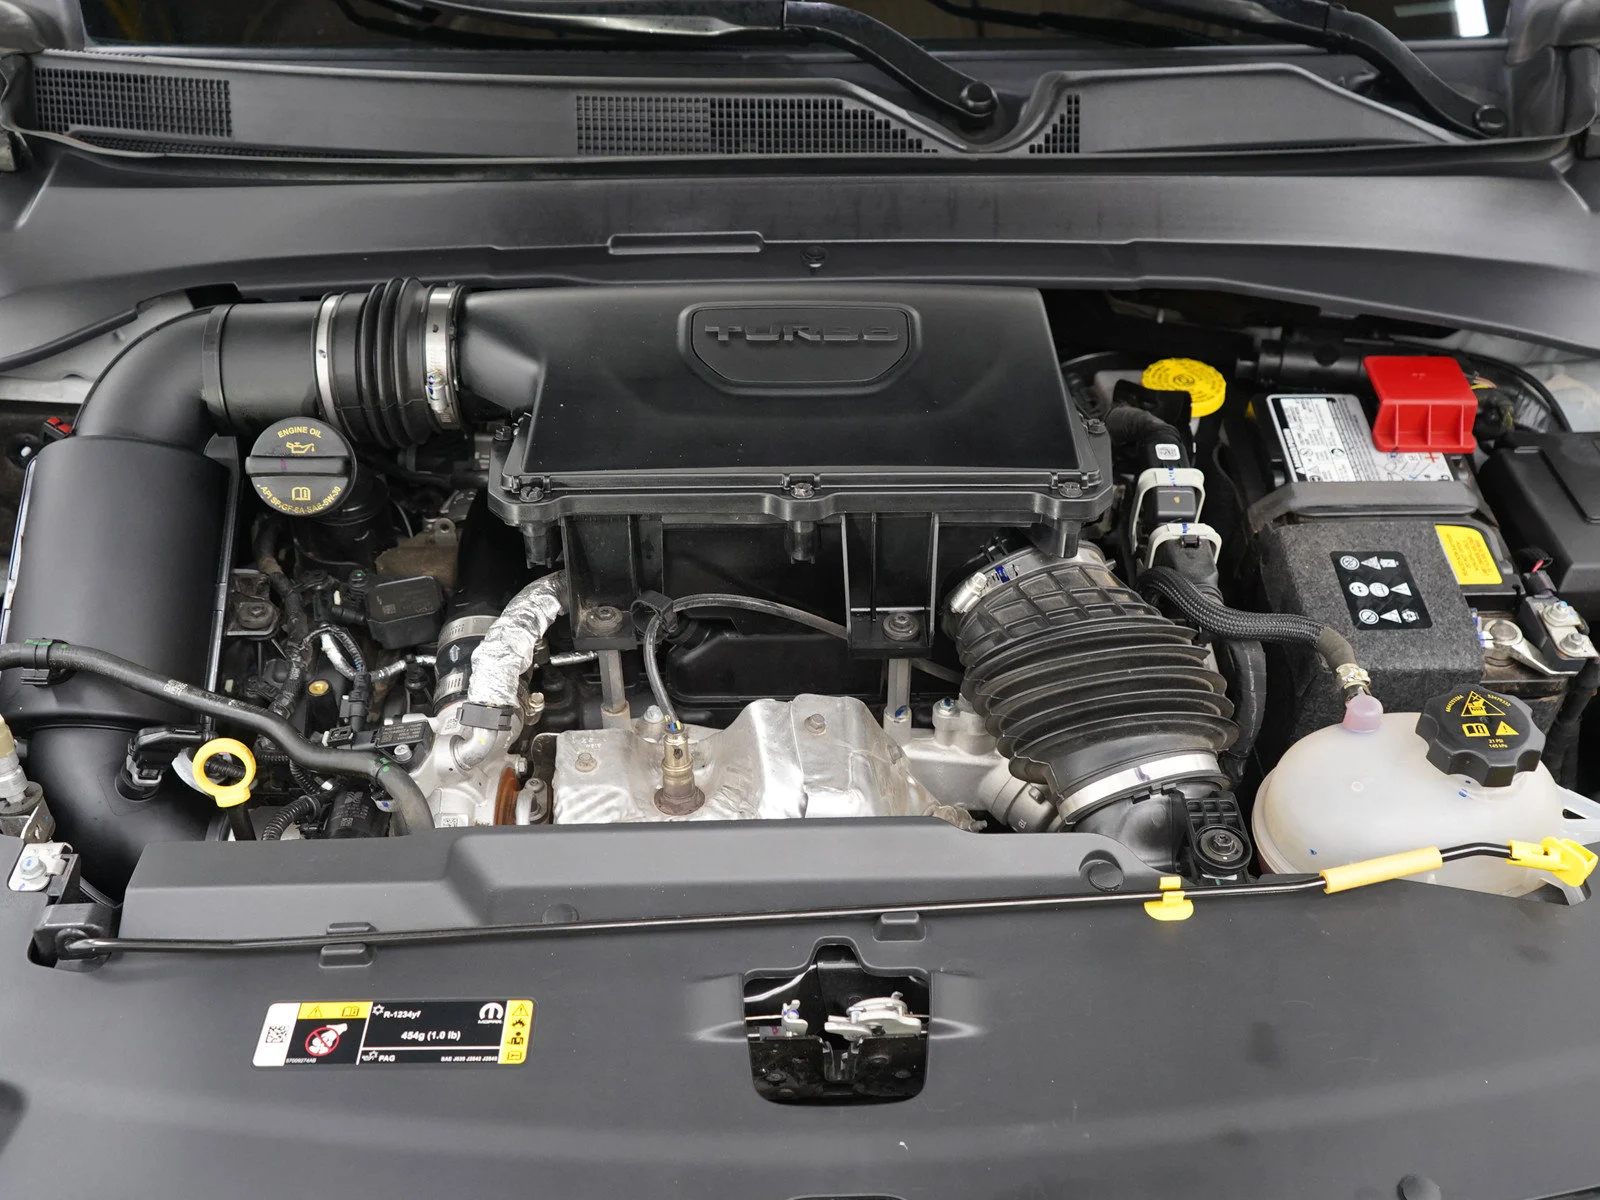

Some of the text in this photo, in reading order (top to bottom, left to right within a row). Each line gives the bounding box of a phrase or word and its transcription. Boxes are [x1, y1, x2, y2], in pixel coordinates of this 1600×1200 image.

[704, 324, 899, 342] TURBO
[277, 426, 322, 439] ENGINE OIL
[260, 486, 273, 500] API
[383, 1010, 422, 1020] R-1234yf
[400, 1030, 461, 1041] 454g (1.0 lb)
